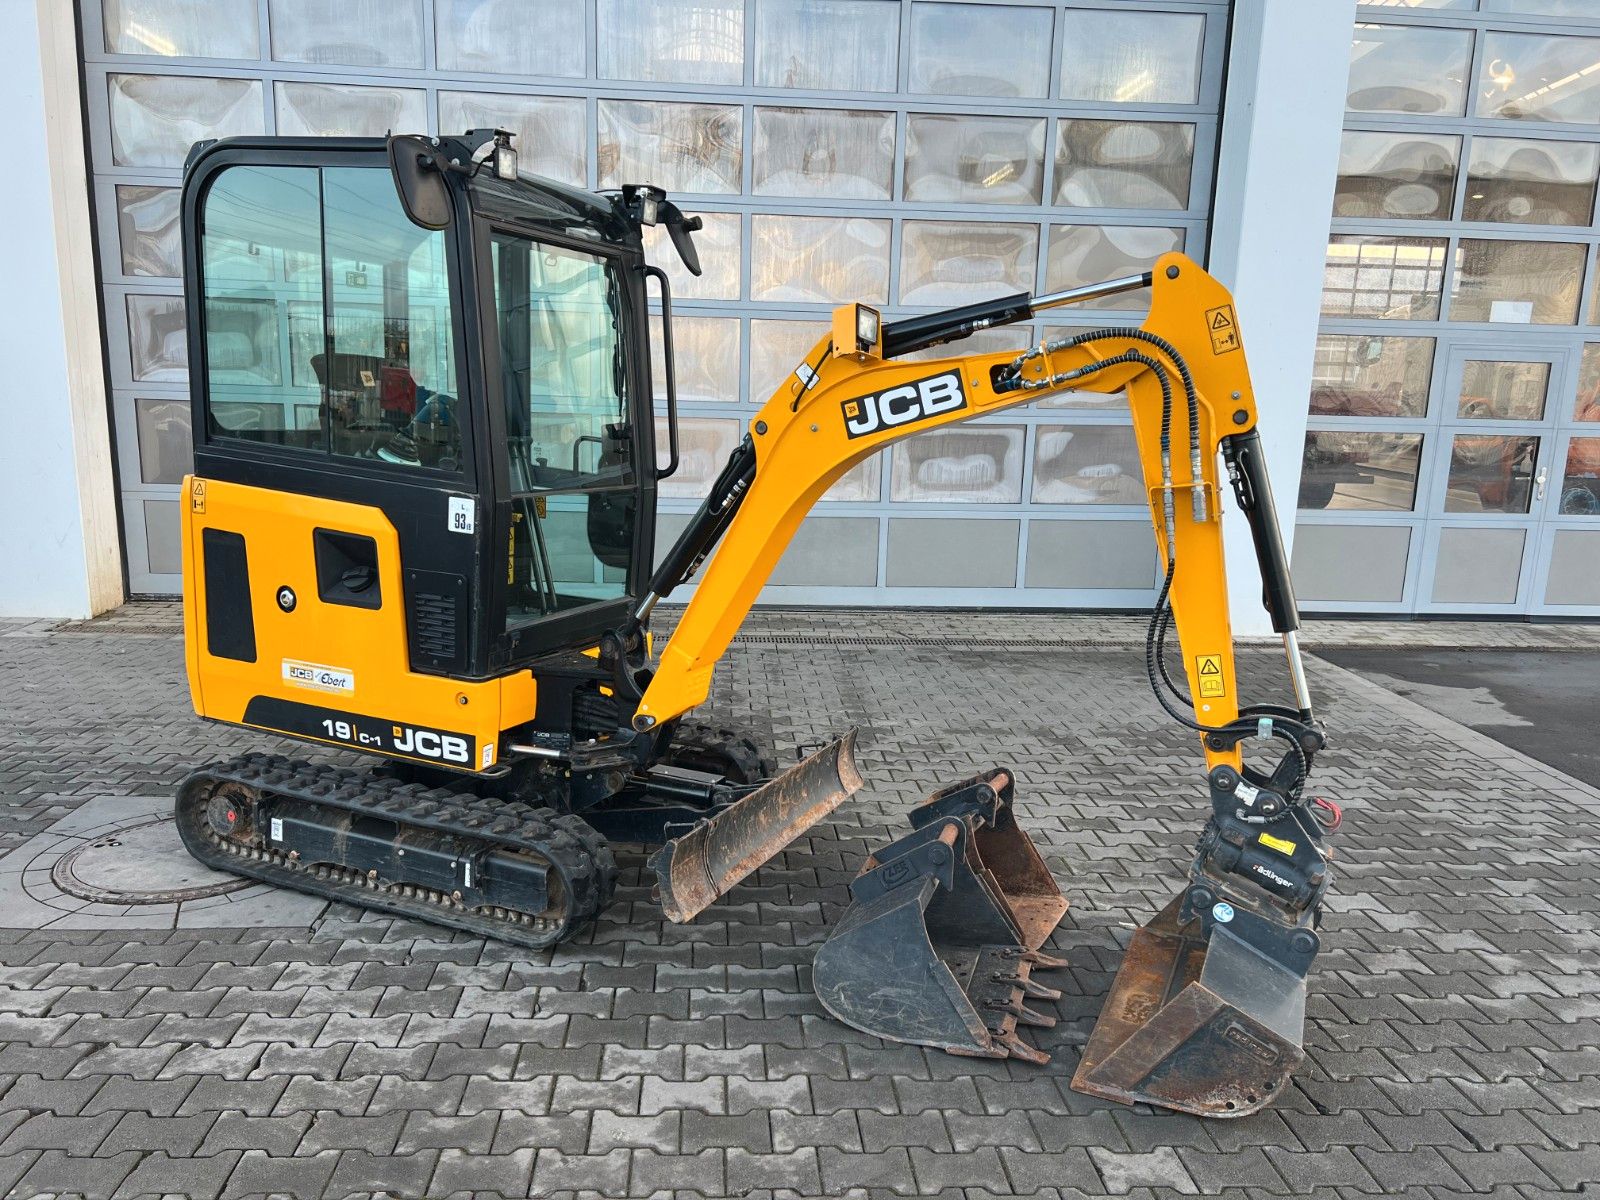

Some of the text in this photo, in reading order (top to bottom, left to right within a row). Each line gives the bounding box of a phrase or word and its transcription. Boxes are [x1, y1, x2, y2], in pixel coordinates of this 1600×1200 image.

[848, 374, 963, 435] JCB
[455, 513, 466, 530] 93
[290, 667, 313, 680] JCB
[321, 672, 346, 687] Ebert
[322, 719, 351, 740] 19
[393, 728, 469, 763] JCB
